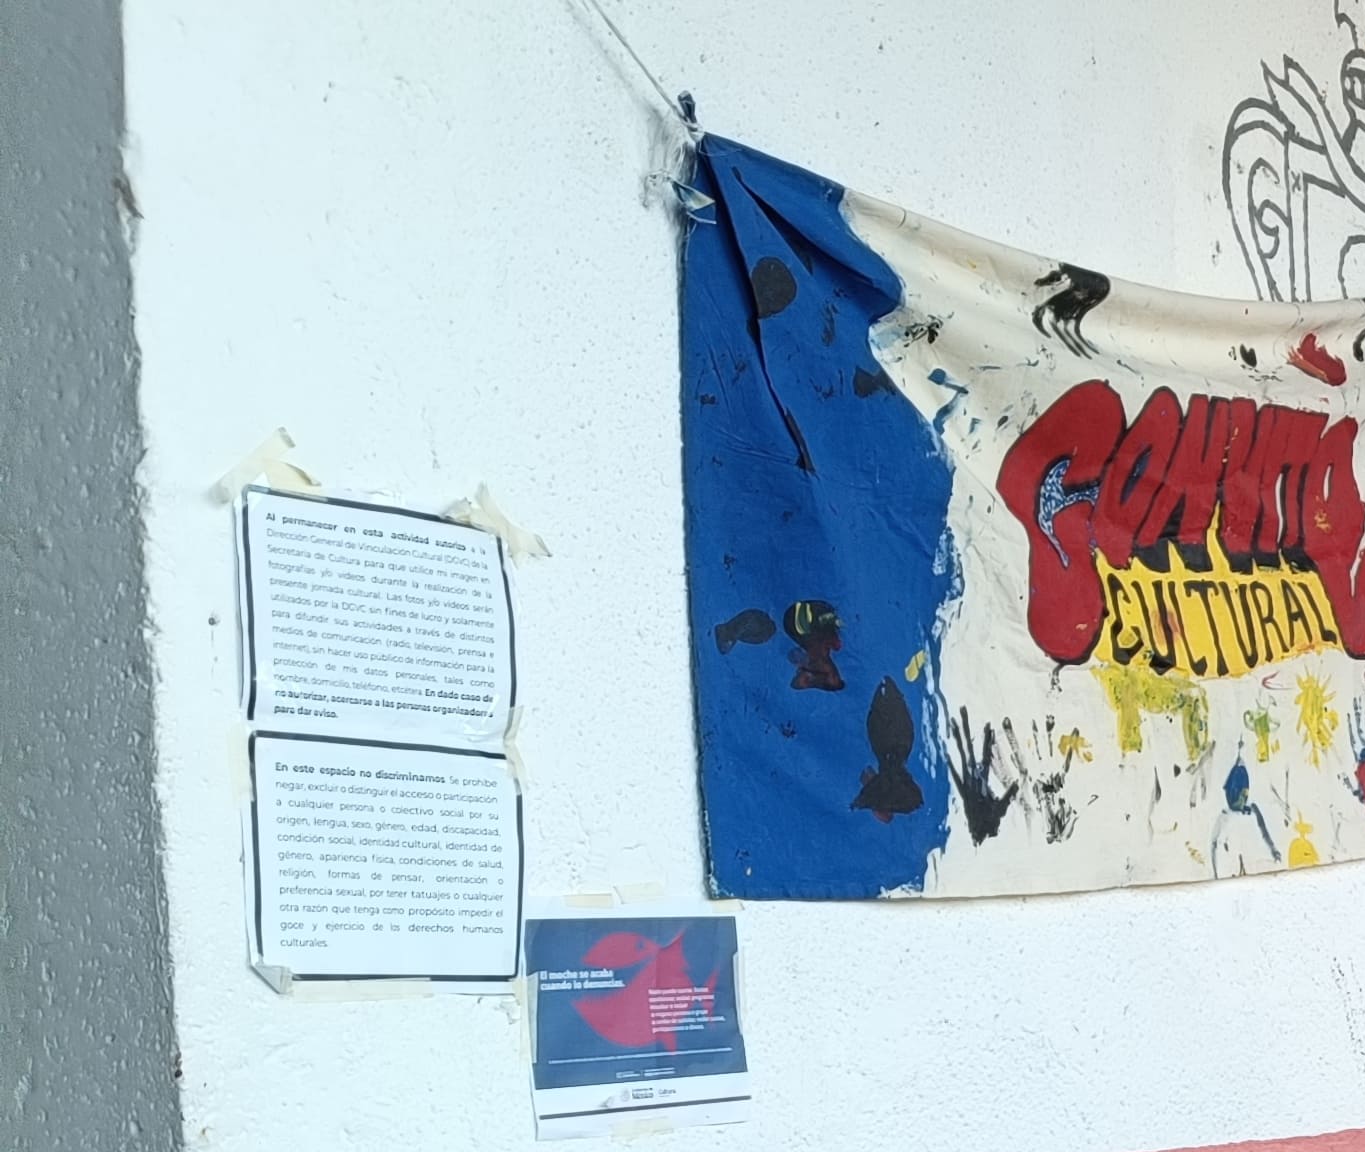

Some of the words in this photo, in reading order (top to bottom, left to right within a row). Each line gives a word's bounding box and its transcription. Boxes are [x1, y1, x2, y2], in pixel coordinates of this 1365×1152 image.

[266, 511, 275, 521] Al
[344, 525, 355, 533] en
[387, 563, 406, 572] que
[411, 579, 418, 588] la
[386, 591, 402, 602] Las
[314, 599, 328, 609] por
[331, 599, 338, 609] la
[369, 604, 381, 614] sin
[408, 609, 418, 619] de
[444, 616, 449, 625] y
[1106, 573, 1337, 676] CULTURAL
[306, 627, 317, 637] de
[444, 628, 455, 639] de
[324, 661, 336, 671] de
[342, 664, 357, 673] mis
[353, 651, 368, 659] uso
[404, 654, 413, 664] de
[487, 664, 494, 673] la
[425, 687, 435, 697] En
[482, 693, 493, 703] de
[382, 698, 394, 708] las
[297, 705, 311, 715] dar
[275, 761, 288, 771] En
[449, 775, 458, 784] Se
[390, 787, 397, 796] el
[469, 811, 482, 820] por
[490, 842, 502, 852] de
[461, 858, 473, 867] de
[370, 871, 382, 880] de
[369, 890, 383, 898] por
[331, 906, 350, 914] que
[495, 908, 503, 917] el
[312, 923, 317, 931] y
[372, 921, 383, 930] de
[390, 922, 400, 931] los
